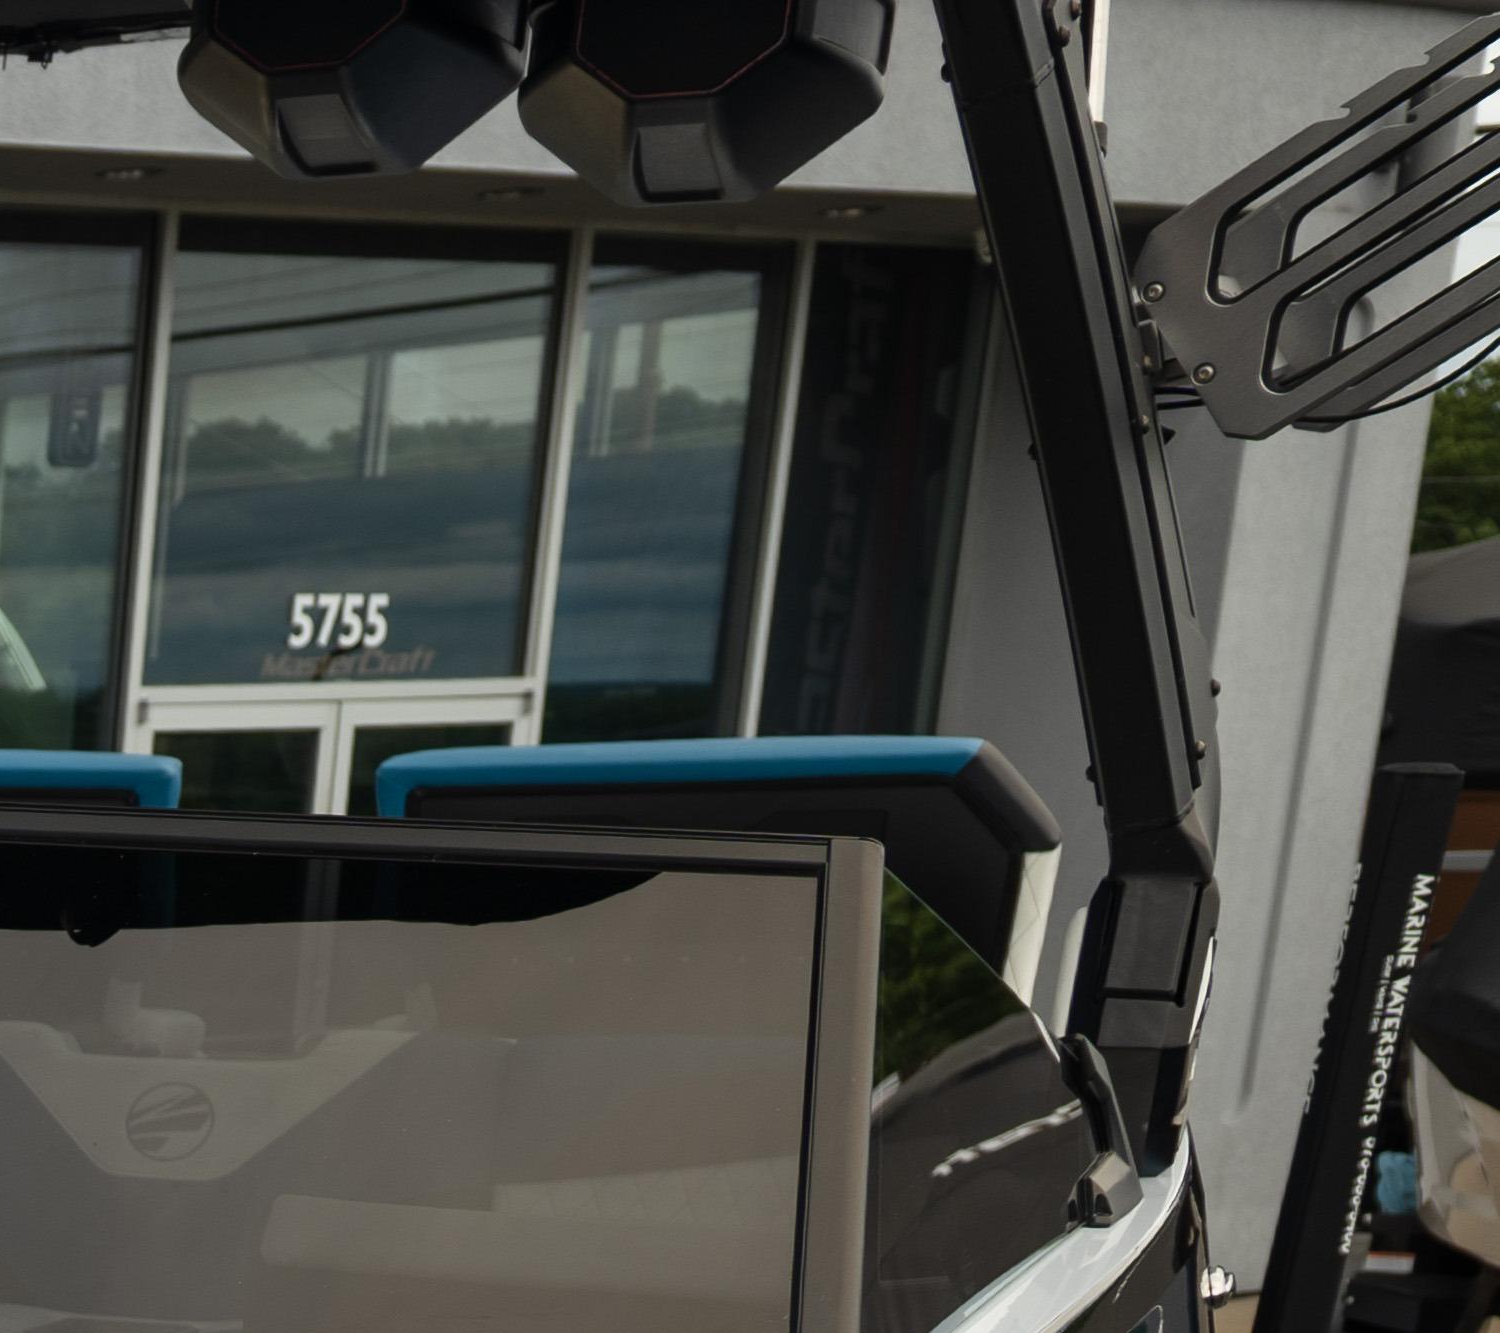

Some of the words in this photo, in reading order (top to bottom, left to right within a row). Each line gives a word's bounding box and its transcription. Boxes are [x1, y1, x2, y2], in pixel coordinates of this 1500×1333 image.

[287, 592, 391, 648] 5755
[1392, 873, 1436, 969] MARINE
[1358, 973, 1413, 1128] WATERSPORTS
